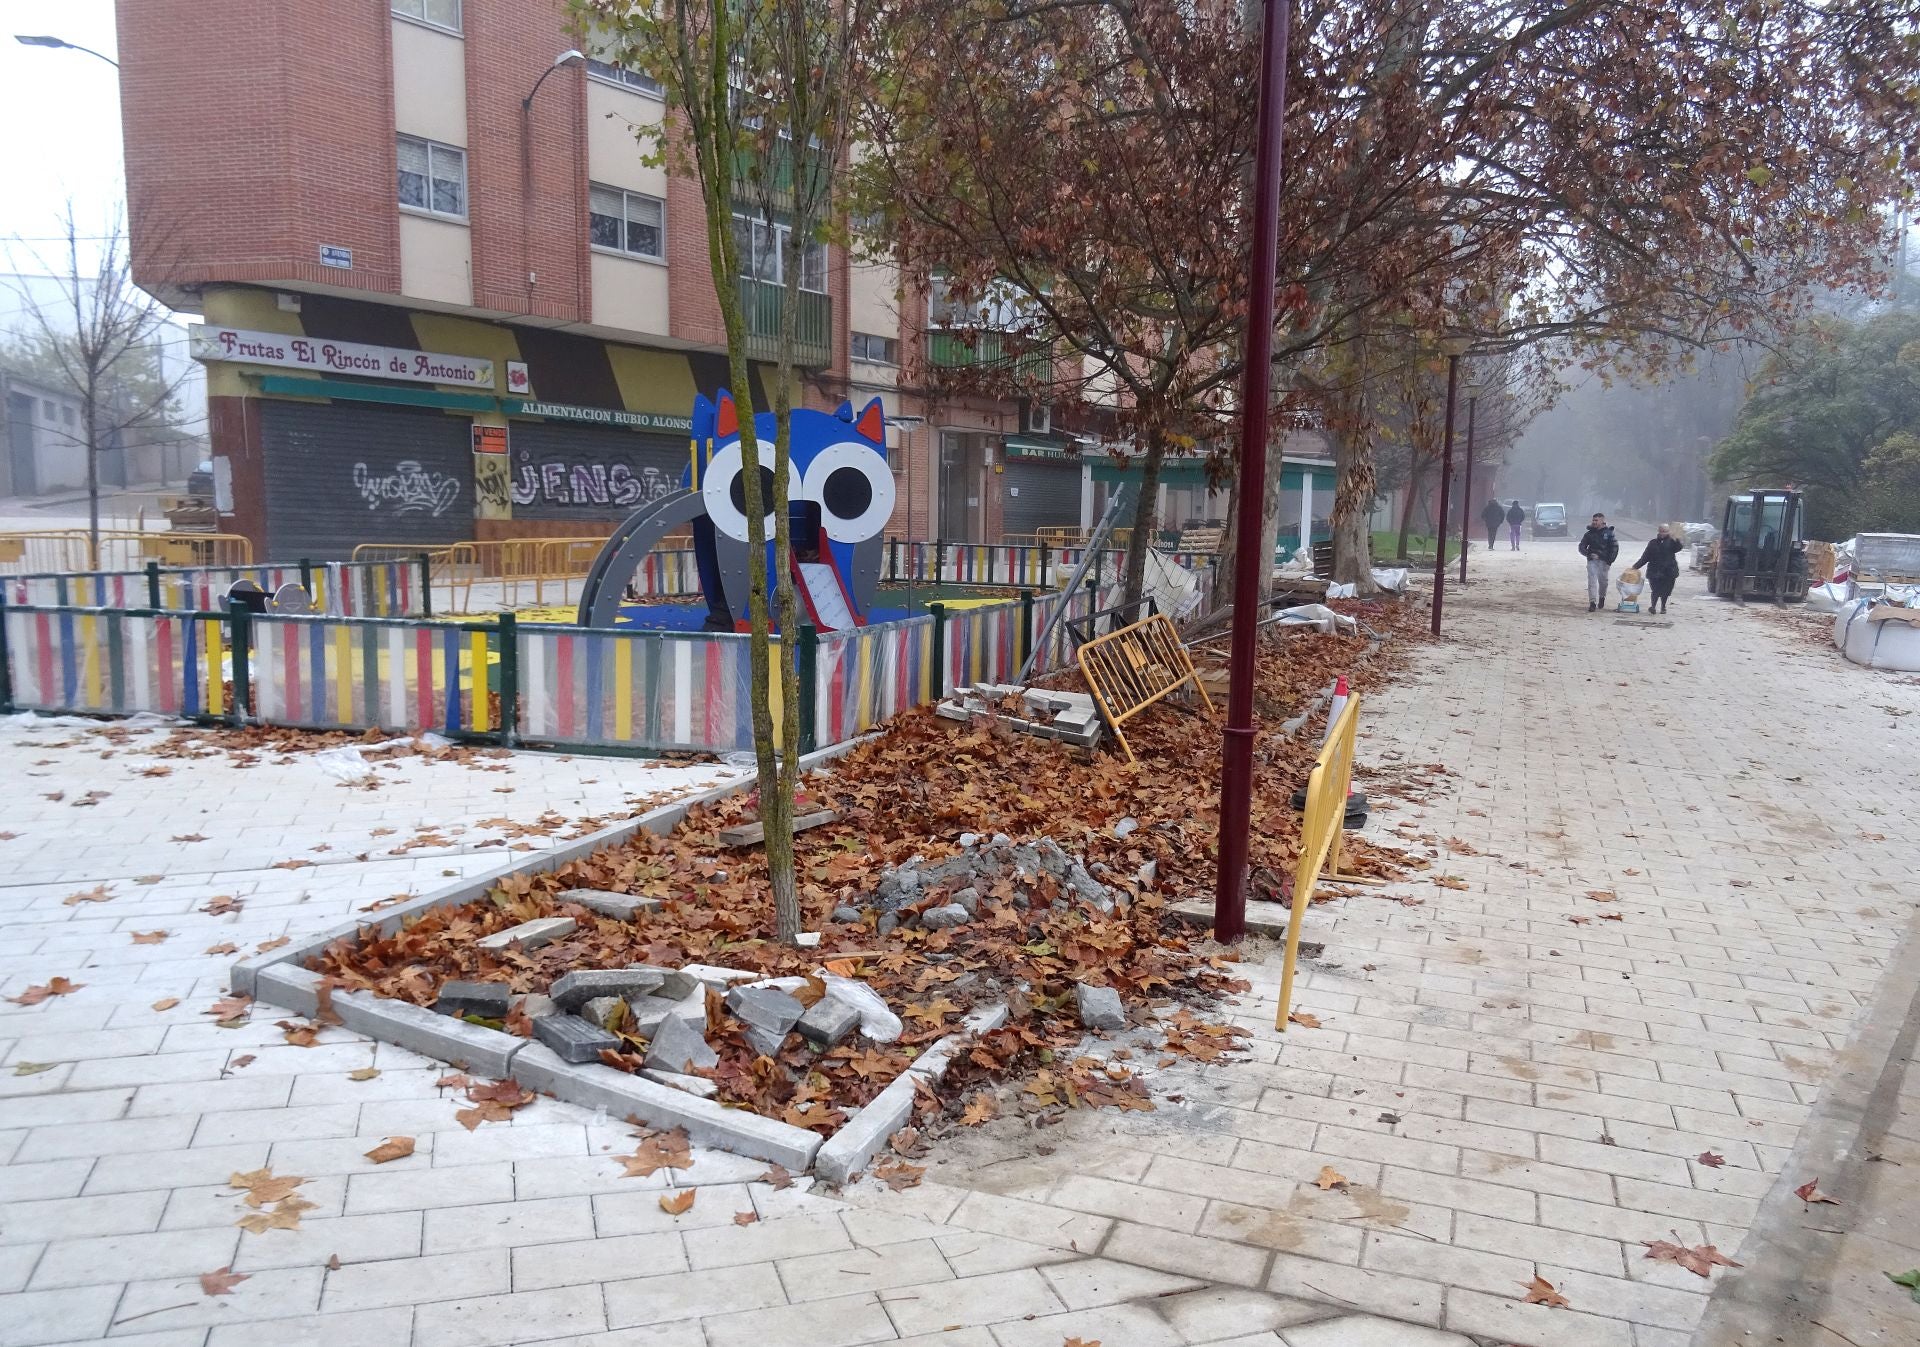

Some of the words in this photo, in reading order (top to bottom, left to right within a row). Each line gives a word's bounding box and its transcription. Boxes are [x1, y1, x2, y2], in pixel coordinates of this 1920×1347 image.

[219, 331, 285, 360] Frutas
[291, 340, 316, 363] El
[322, 344, 380, 371] Rincón
[389, 356, 407, 374] de
[413, 355, 476, 381] Antonio
[521, 402, 611, 422] ALIMENTACION
[615, 412, 650, 426] RUBIO
[1021, 448, 1045, 457] BAR
